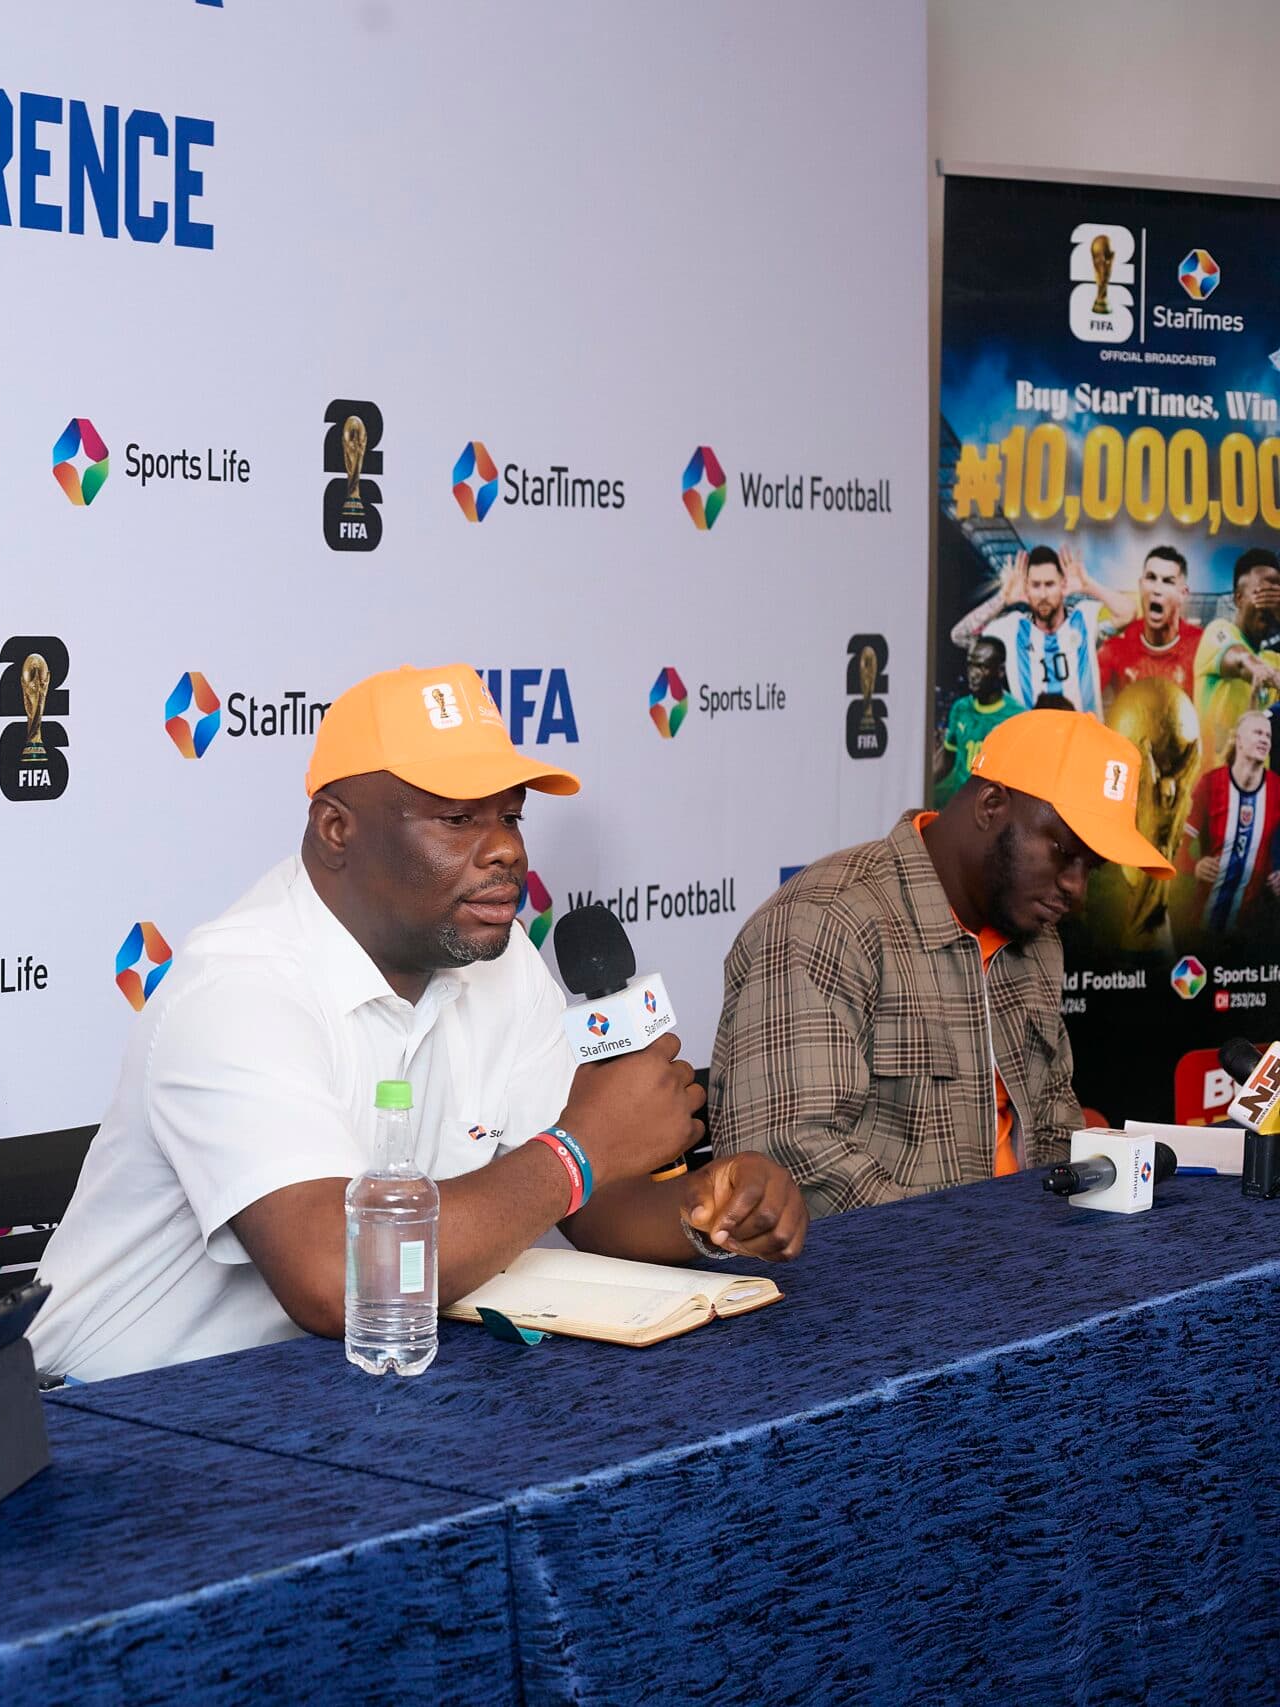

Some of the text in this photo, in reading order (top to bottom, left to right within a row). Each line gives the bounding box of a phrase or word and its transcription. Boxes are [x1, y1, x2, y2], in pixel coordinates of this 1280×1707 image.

[1089, 319, 1114, 332] FIFA
[1153, 305, 1245, 332] StarTimes
[1099, 349, 1217, 368] OFFICIAL BROADCASTER
[1015, 379, 1069, 421] Buy
[1225, 390, 1279, 422] Win
[125, 443, 251, 487] Sports Life
[503, 463, 625, 510] StarTimes
[740, 472, 892, 514] World Football
[339, 522, 368, 541] FIFA
[1040, 652, 1069, 682] 10
[227, 691, 332, 738] StarTi
[475, 668, 580, 746] FA
[699, 682, 786, 719] Sports Life
[857, 733, 879, 751] FIFA
[18, 769, 52, 788] FIFA
[568, 876, 737, 924] Wrld Football
[0, 956, 48, 995] Life
[1082, 970, 1147, 991] Football
[1213, 963, 1280, 988] Sports Lif
[644, 1013, 671, 1037] StarTimes
[579, 1037, 632, 1058] StarTimes
